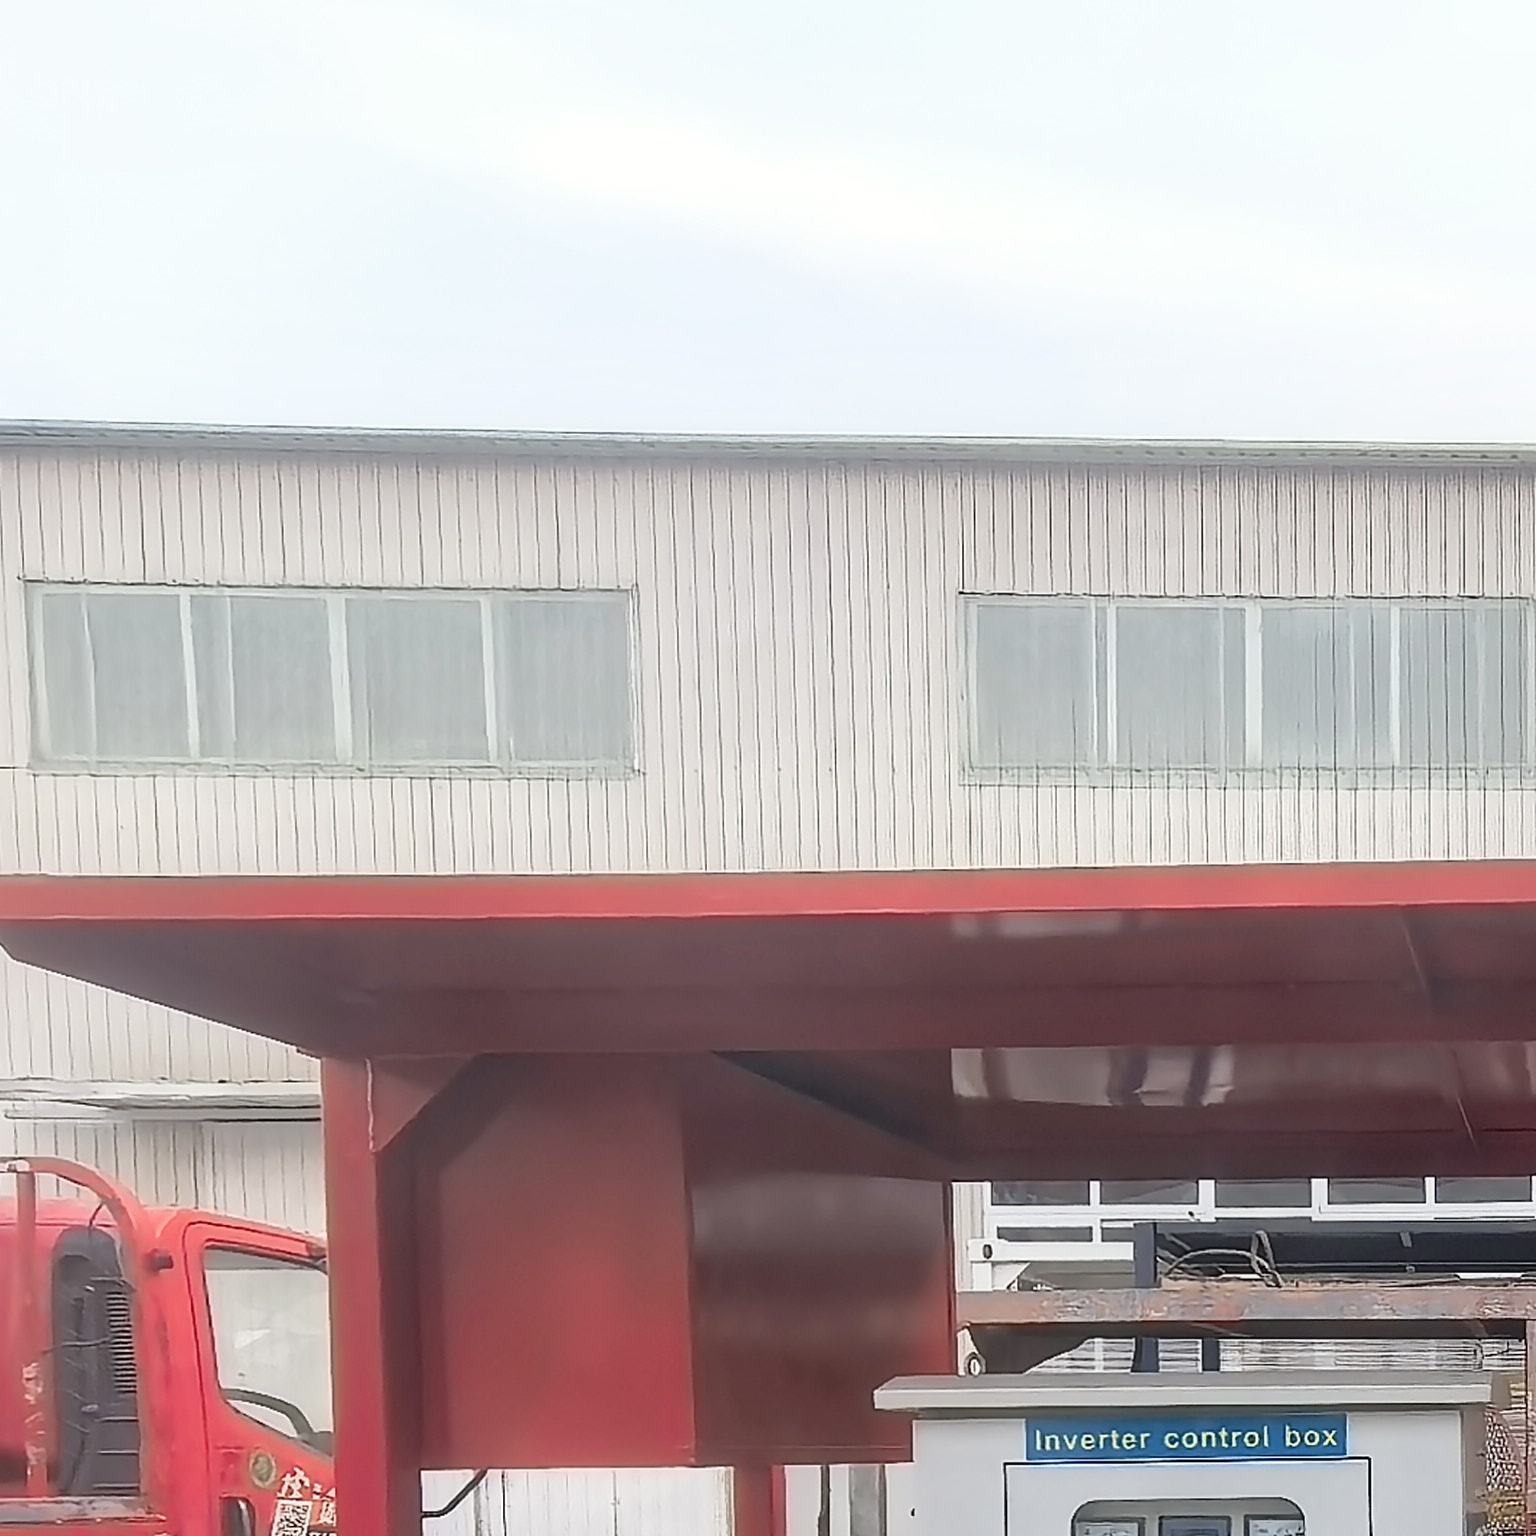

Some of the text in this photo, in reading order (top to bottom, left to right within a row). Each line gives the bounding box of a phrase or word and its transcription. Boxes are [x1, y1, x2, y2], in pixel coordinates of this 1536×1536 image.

[1034, 1424, 1338, 1451] Inverter control box
